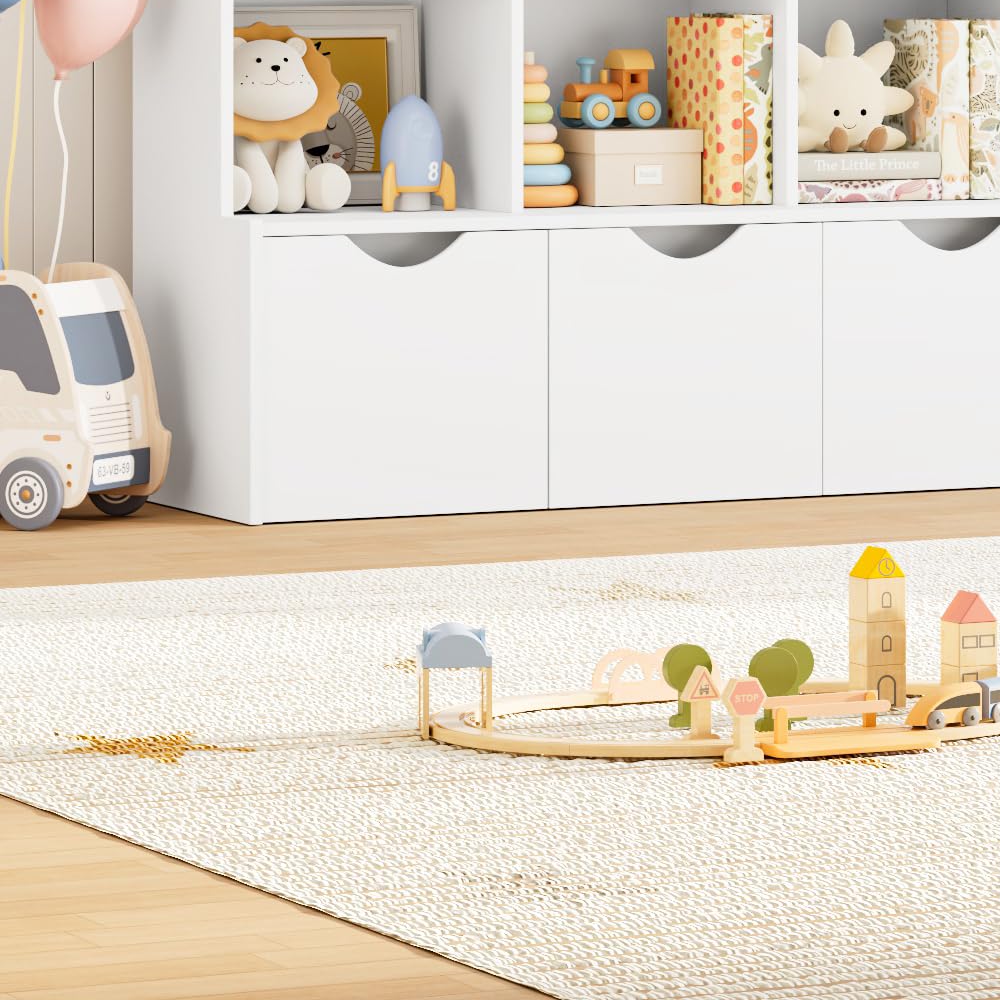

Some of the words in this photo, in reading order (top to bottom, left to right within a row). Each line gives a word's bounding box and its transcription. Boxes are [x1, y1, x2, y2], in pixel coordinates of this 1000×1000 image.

[427, 161, 439, 182] 8
[814, 158, 837, 173] The
[840, 158, 877, 171] Little
[880, 158, 920, 171] Prince
[735, 693, 759, 704] STOP
